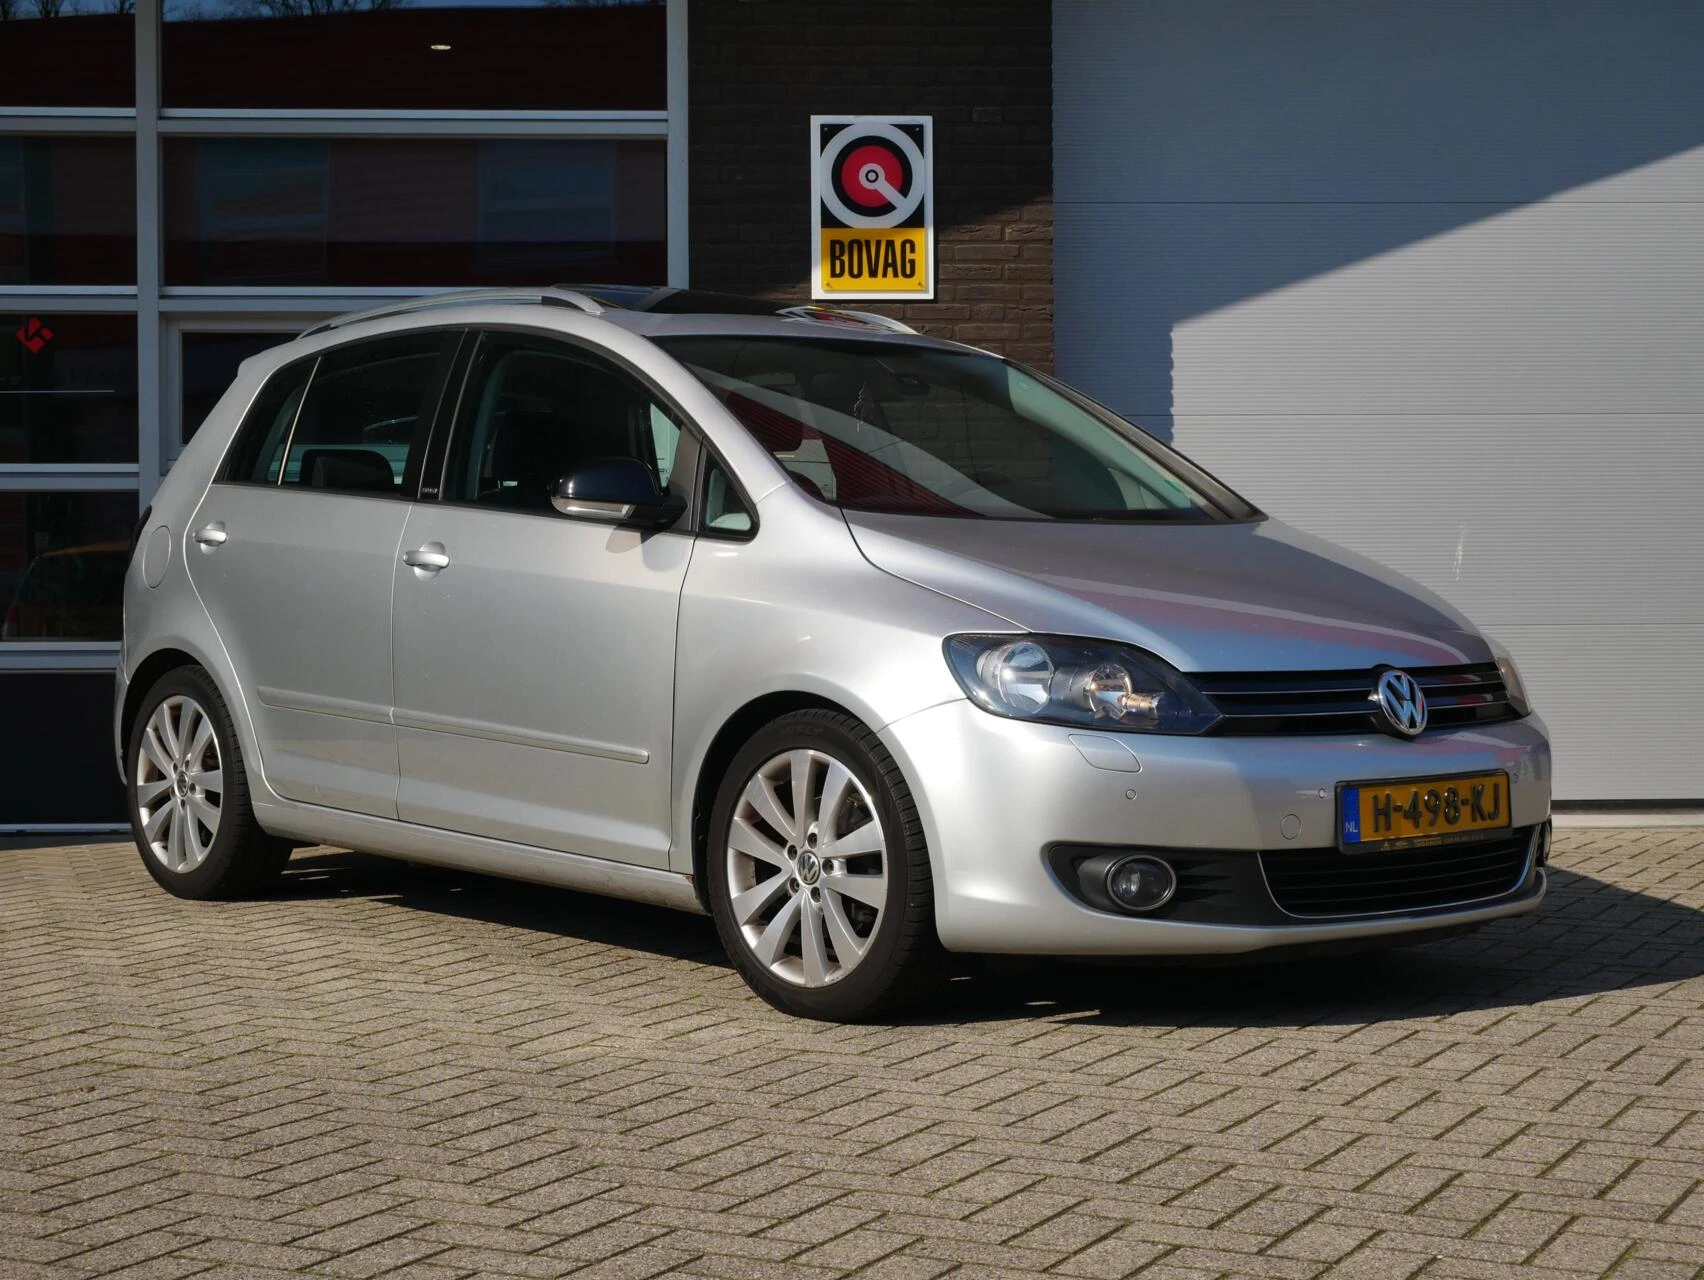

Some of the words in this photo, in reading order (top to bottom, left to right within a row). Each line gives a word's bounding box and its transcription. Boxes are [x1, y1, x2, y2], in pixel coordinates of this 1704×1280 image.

[829, 239, 916, 279] BOVAG
[1345, 822, 1359, 833] NL
[1372, 783, 1500, 833] H-498-KJ
